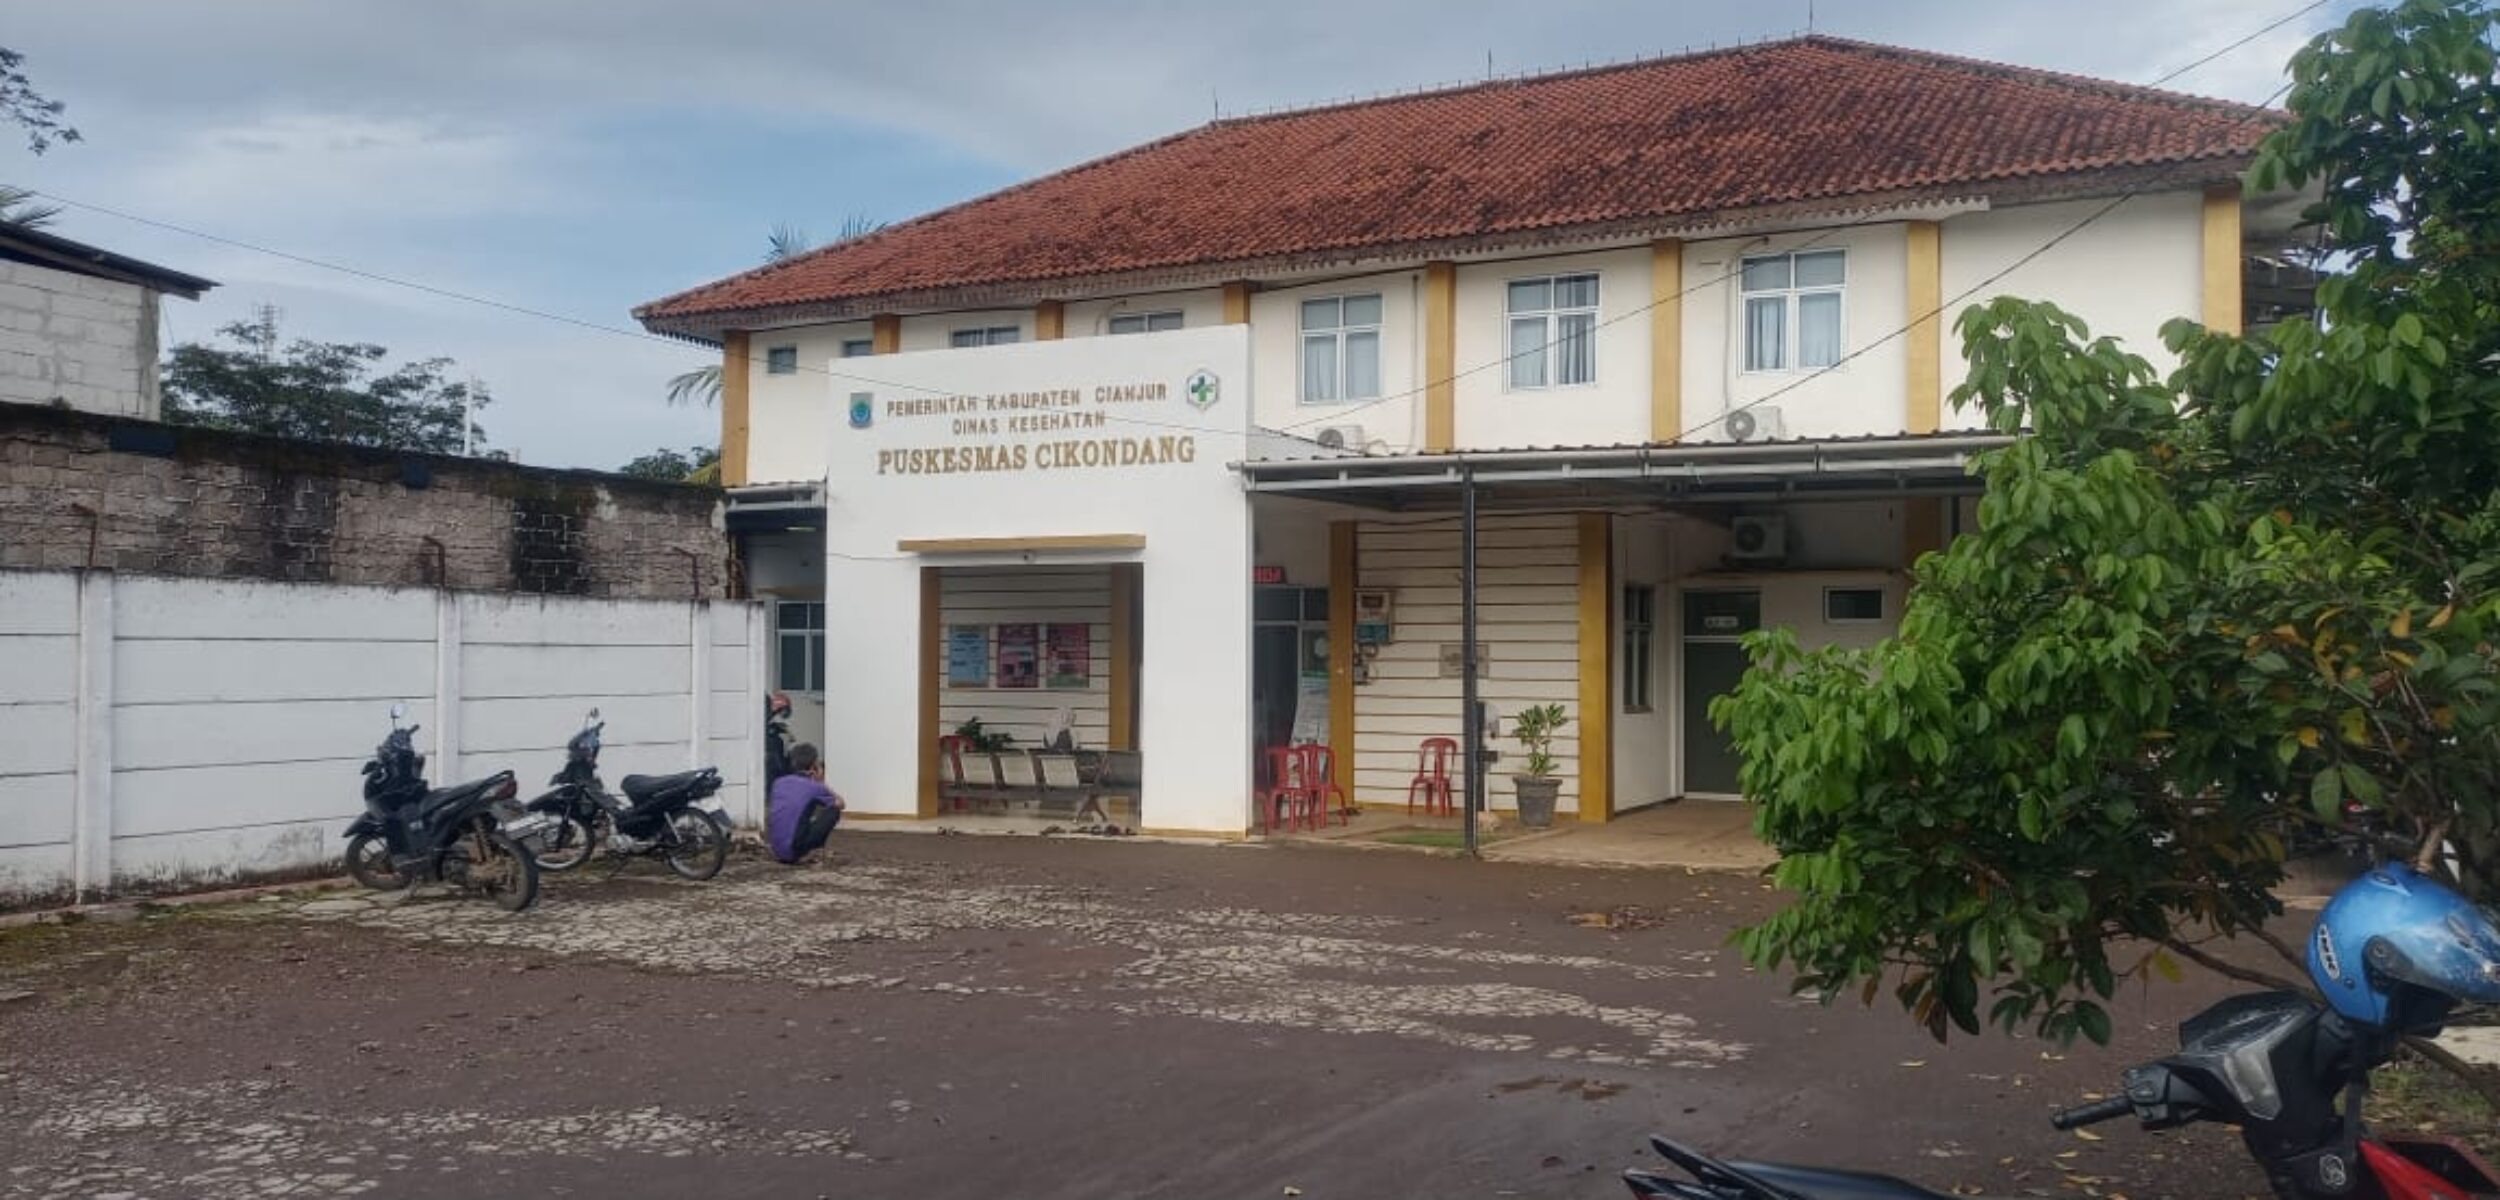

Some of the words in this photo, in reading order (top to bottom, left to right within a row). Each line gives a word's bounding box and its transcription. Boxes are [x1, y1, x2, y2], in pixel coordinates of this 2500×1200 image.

[887, 395, 978, 417] PEMERINTAH
[987, 388, 1080, 411] KABUPATEN
[1095, 383, 1167, 404] CIANJUR
[953, 418, 999, 435] DINAS
[1009, 410, 1106, 433] KESEHATAN
[878, 444, 1028, 475] PUSKESMAS
[1035, 435, 1195, 469] CIKONDANG
